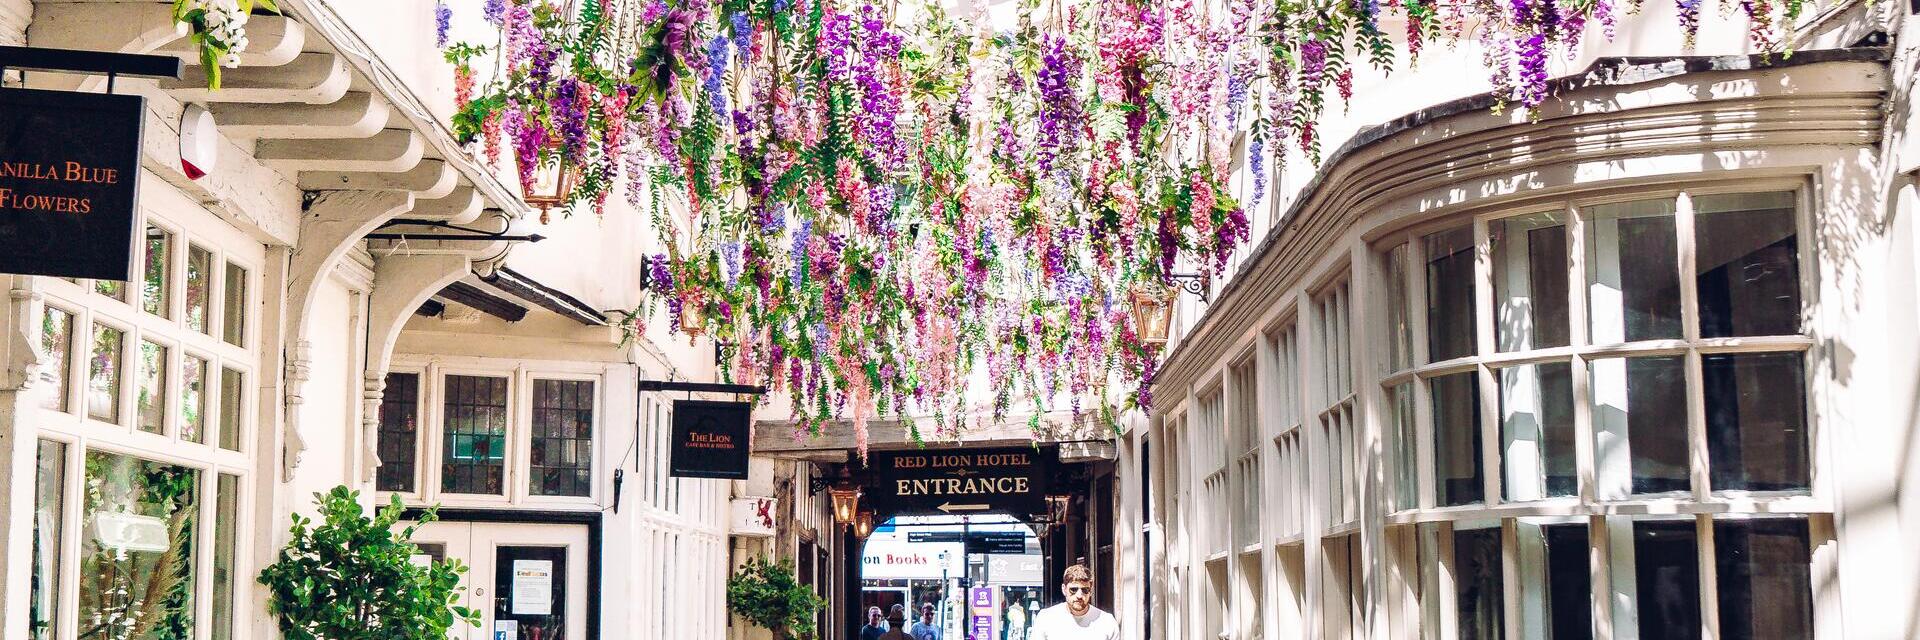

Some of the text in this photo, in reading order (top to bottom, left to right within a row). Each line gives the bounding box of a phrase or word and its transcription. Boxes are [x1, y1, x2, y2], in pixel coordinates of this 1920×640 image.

[64, 161, 118, 184] BLUE
[0, 188, 91, 214] FLOWERS
[690, 432, 708, 442] THE
[894, 453, 1031, 468] RED LION HOTEL
[896, 477, 1029, 495] ENTRANCE
[886, 553, 928, 565] Books
